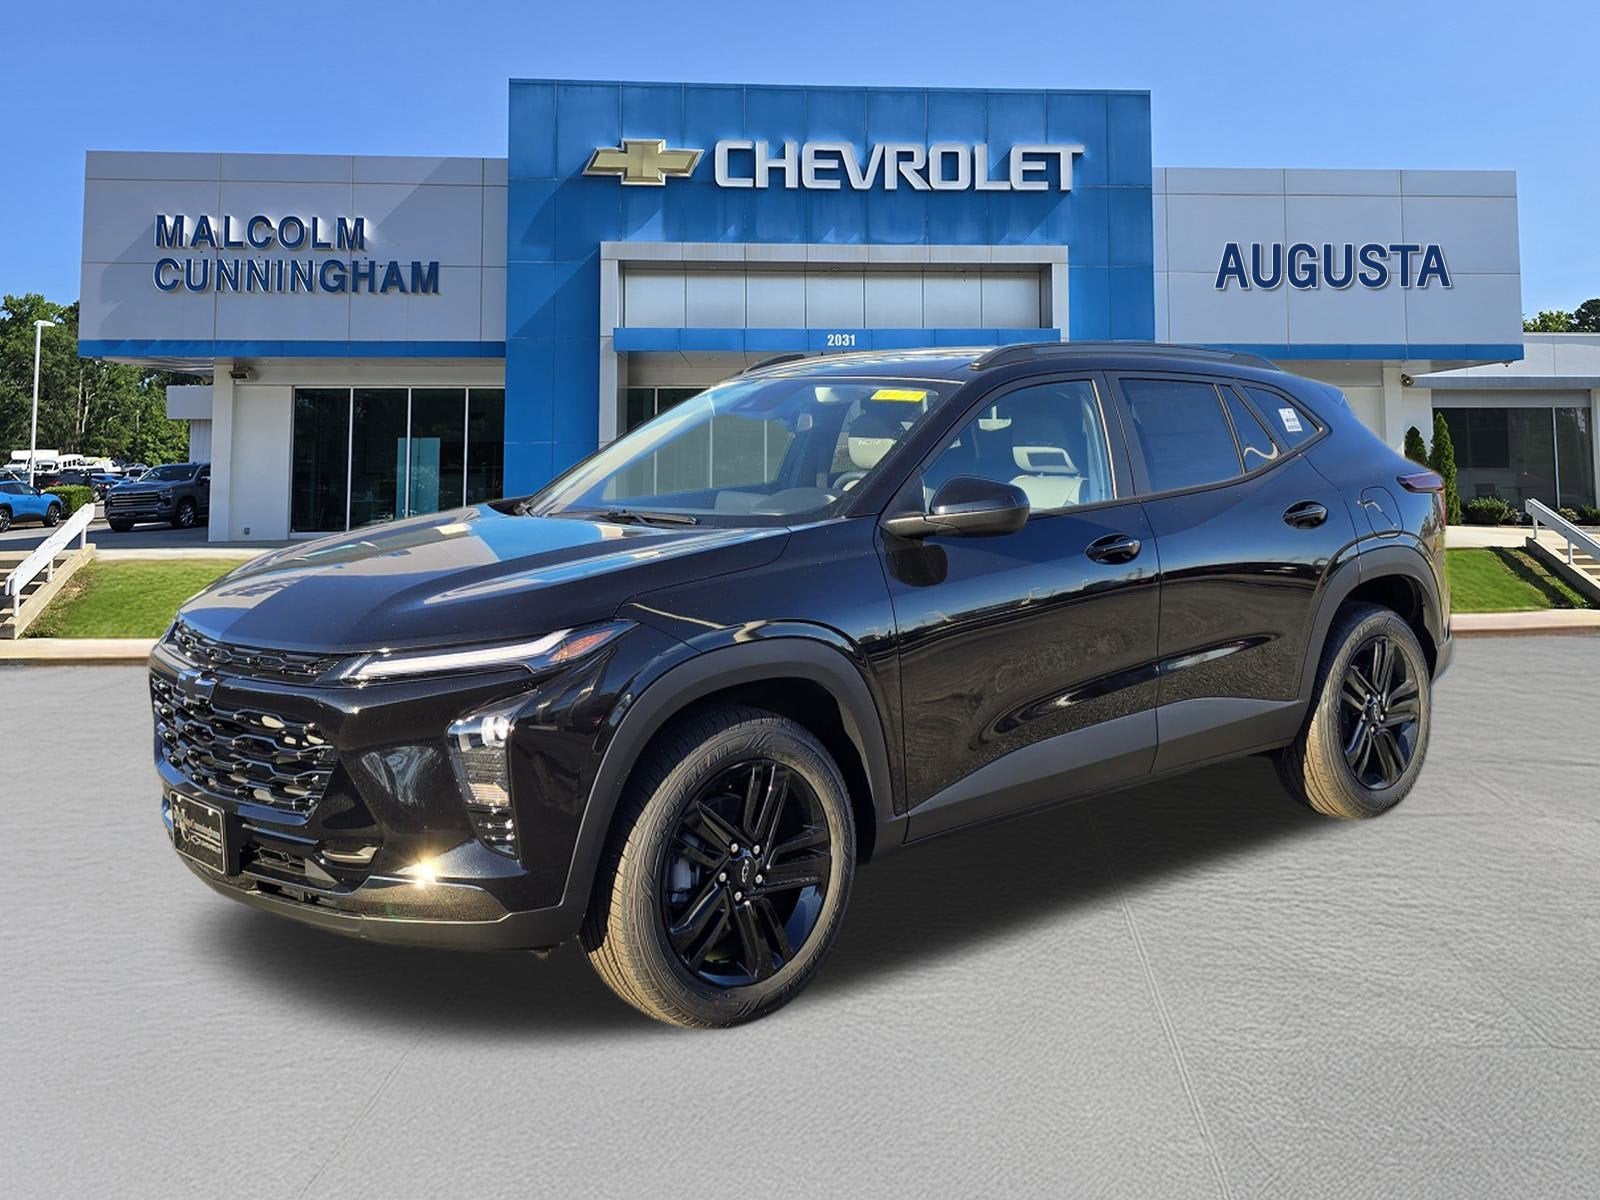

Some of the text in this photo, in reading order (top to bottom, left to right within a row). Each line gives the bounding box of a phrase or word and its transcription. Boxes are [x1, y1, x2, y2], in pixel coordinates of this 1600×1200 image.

[714, 140, 1085, 191] CHEVROLET
[156, 214, 366, 250] MALCOLM
[154, 258, 441, 295] CUNNINGHAM
[1214, 242, 1452, 289] AUGUSTA
[827, 334, 856, 346] 2031
